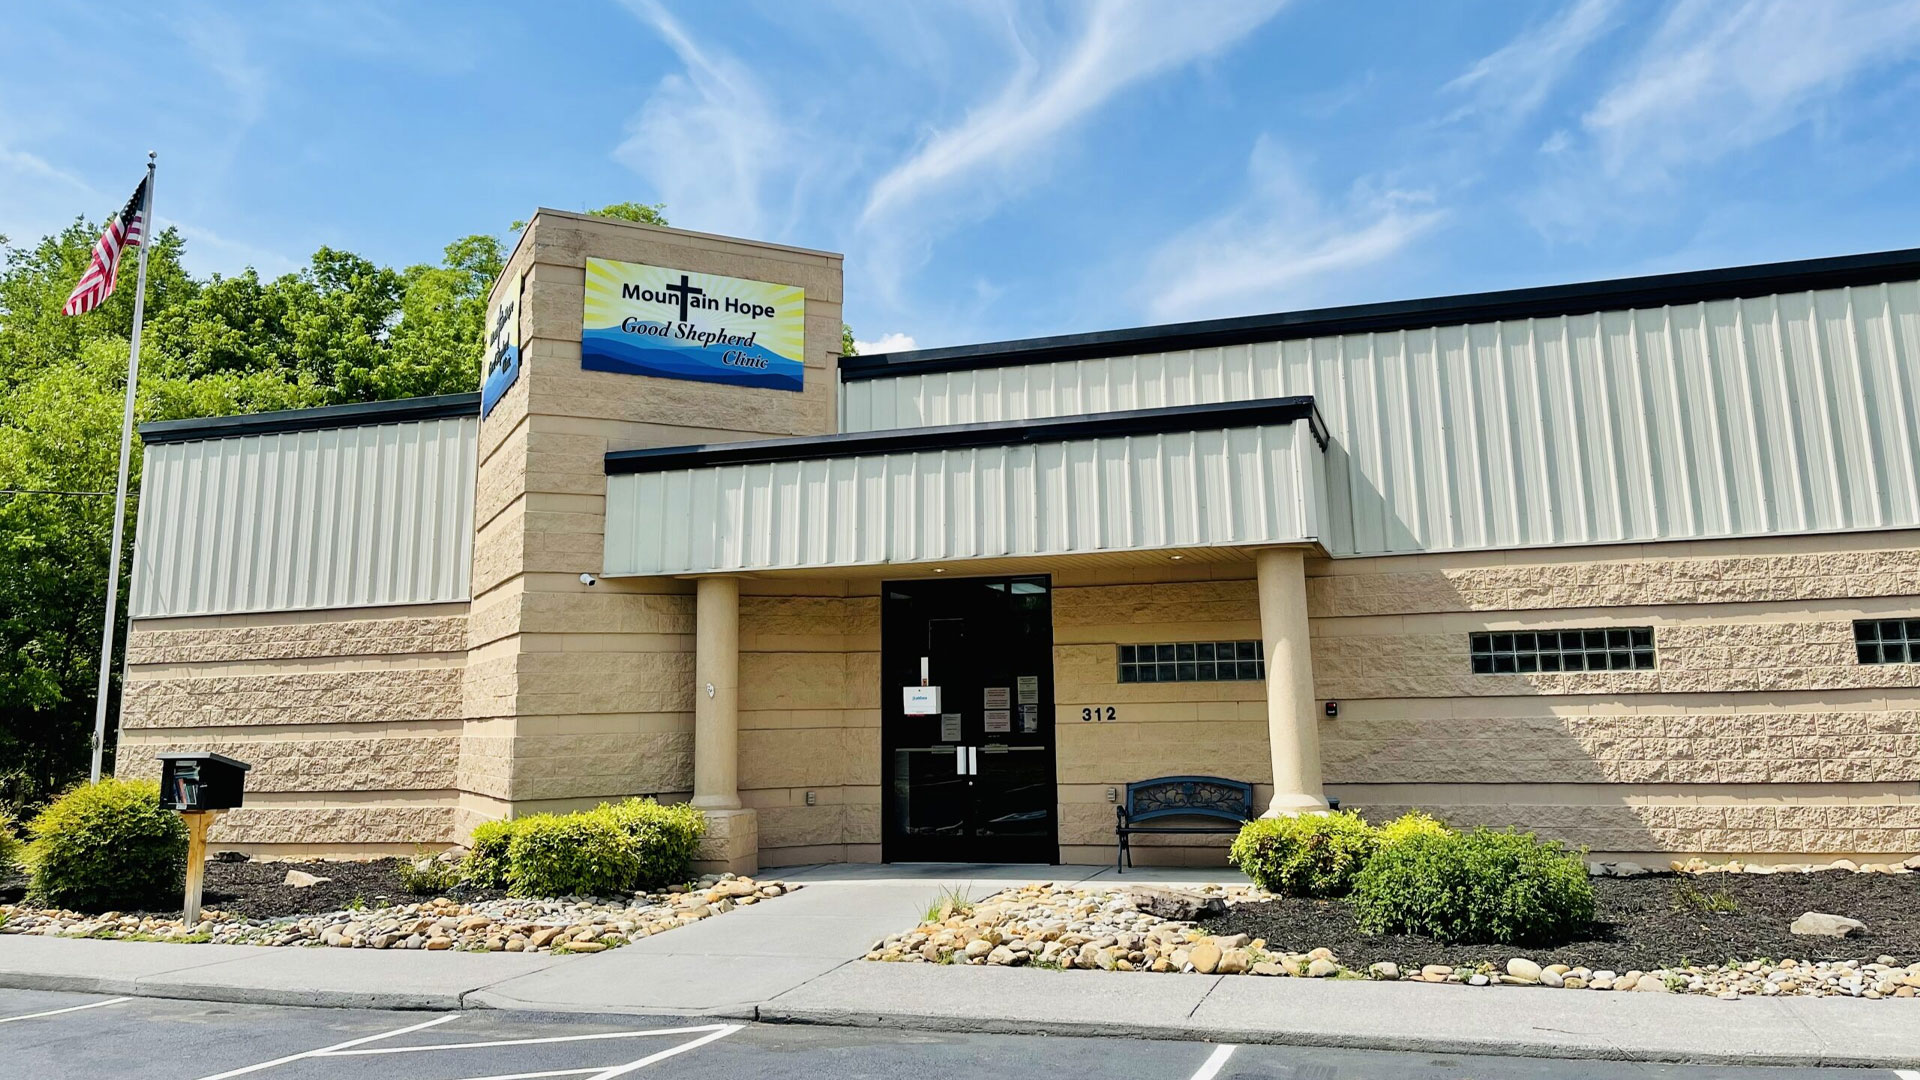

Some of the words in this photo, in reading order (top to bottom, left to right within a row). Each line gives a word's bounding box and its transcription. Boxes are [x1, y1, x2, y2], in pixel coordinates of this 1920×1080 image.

[622, 275, 719, 322] Mountain
[725, 297, 775, 320] Hope
[621, 316, 672, 338] Good
[674, 323, 756, 349] Shepherd
[722, 350, 769, 369] Clinic
[1082, 706, 1117, 721] 312
